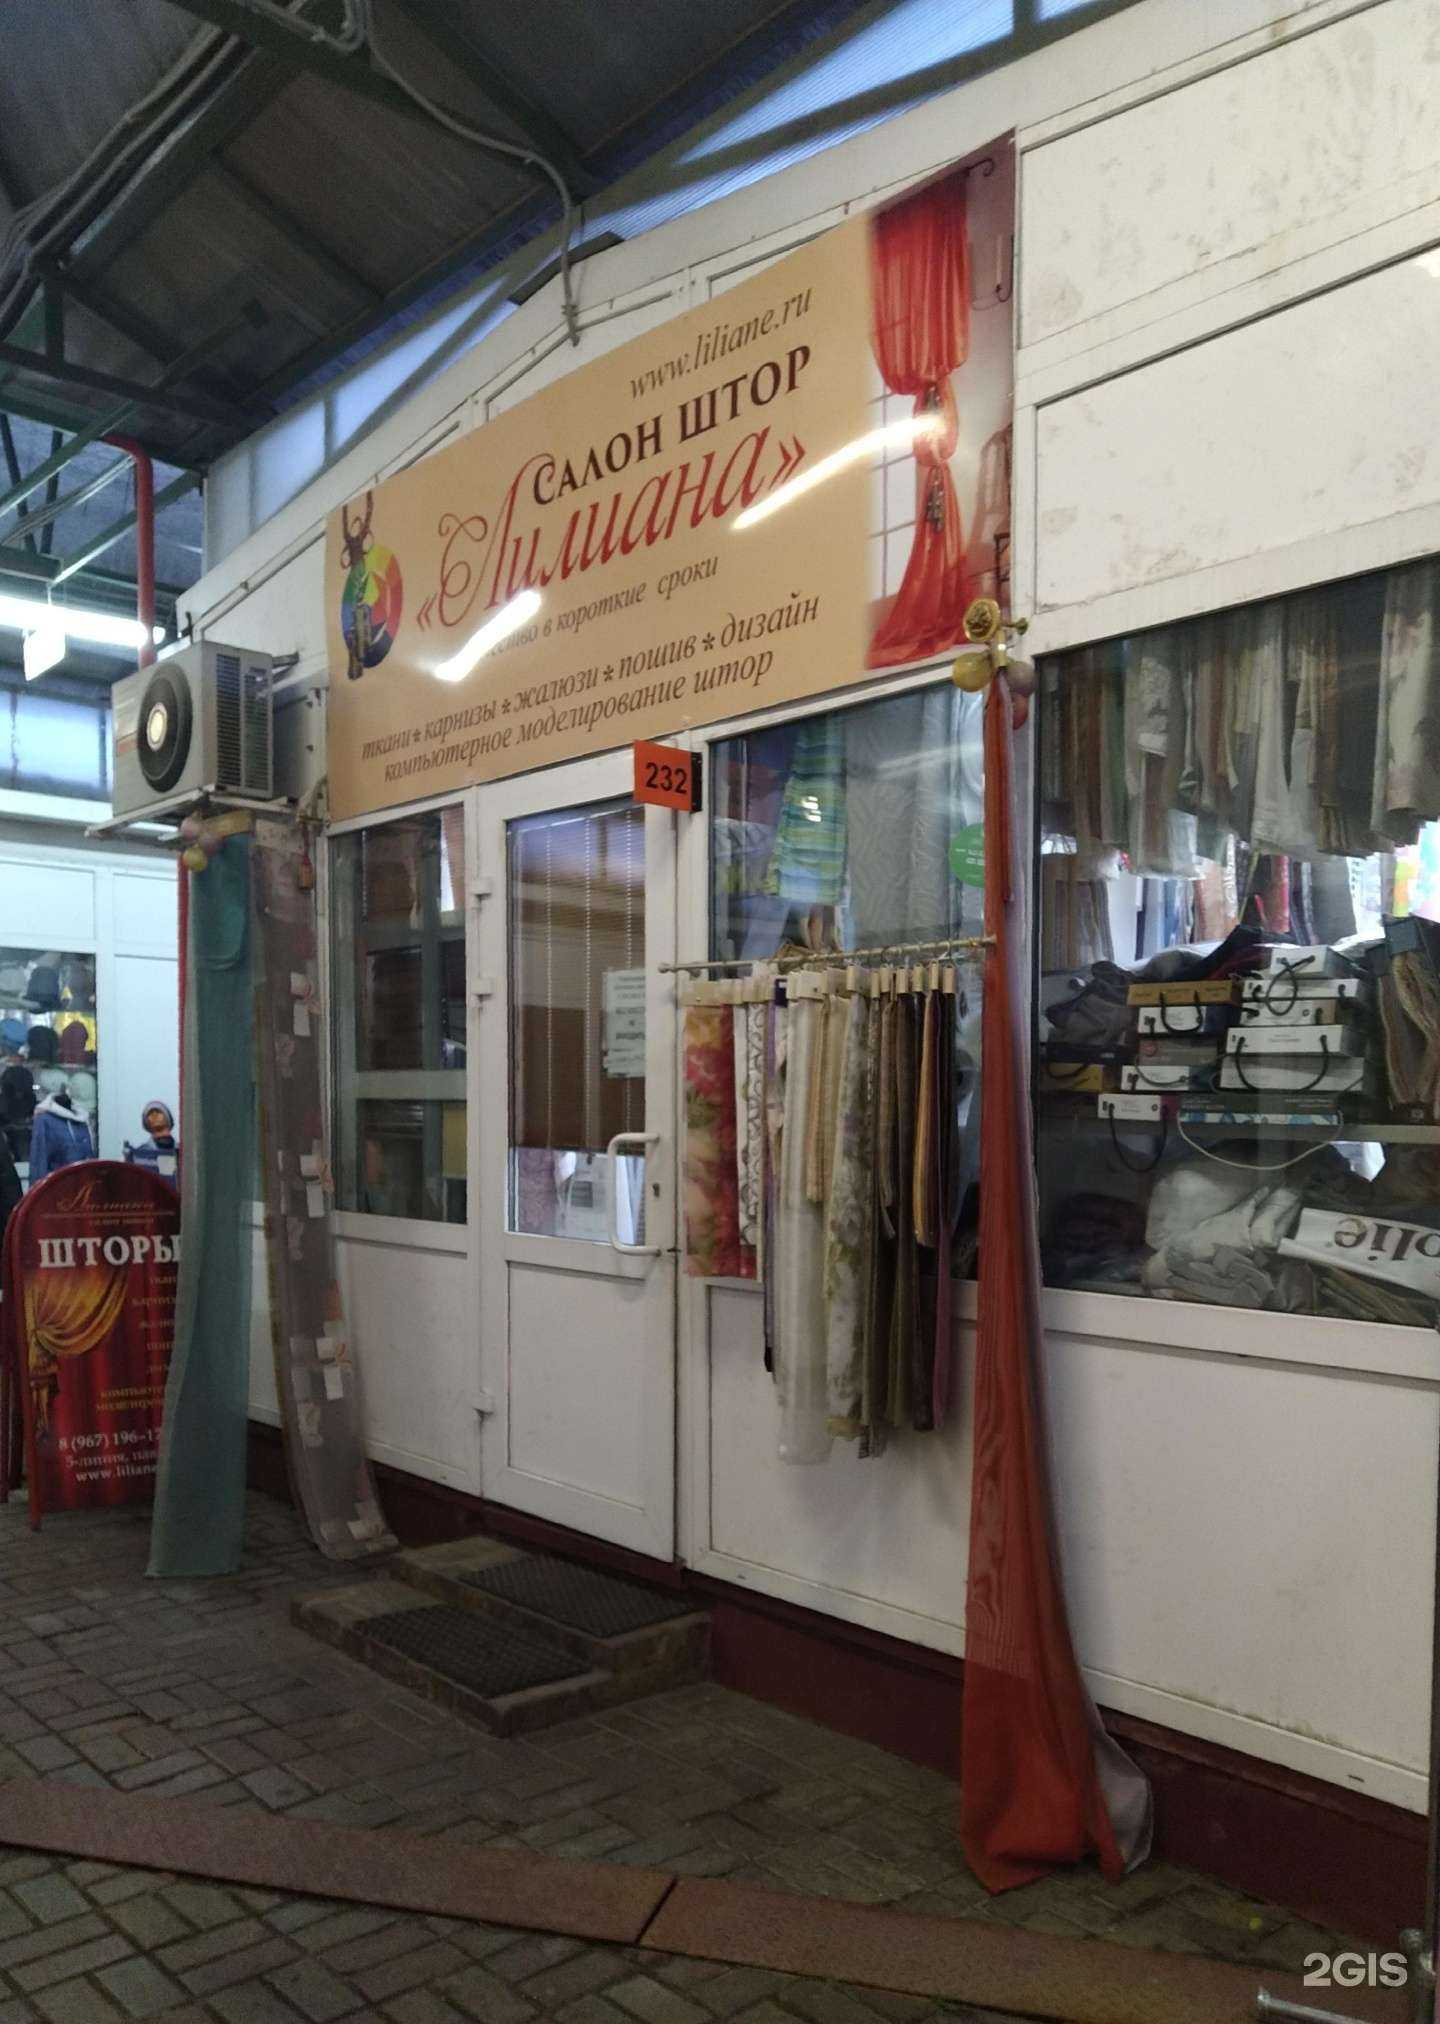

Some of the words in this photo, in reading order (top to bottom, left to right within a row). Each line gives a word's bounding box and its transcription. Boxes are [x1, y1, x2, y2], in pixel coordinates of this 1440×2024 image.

[629, 286, 814, 400] www.liliane.ru
[532, 415, 664, 505] САЛОН
[678, 344, 812, 444] ШТОР
[542, 618, 553, 638] в
[556, 582, 648, 635] короткие
[656, 554, 720, 600] сроки
[361, 728, 413, 760] ткани
[424, 699, 498, 744] карнизы
[514, 667, 600, 713] жалюзи
[618, 633, 698, 680] пошив
[720, 589, 820, 648] дизайн
[384, 727, 513, 783] компьютерное
[516, 674, 687, 746] моделирование
[693, 650, 774, 695] штор
[644, 761, 689, 794] 232
[38, 1234, 182, 1269] ШТОРЫ
